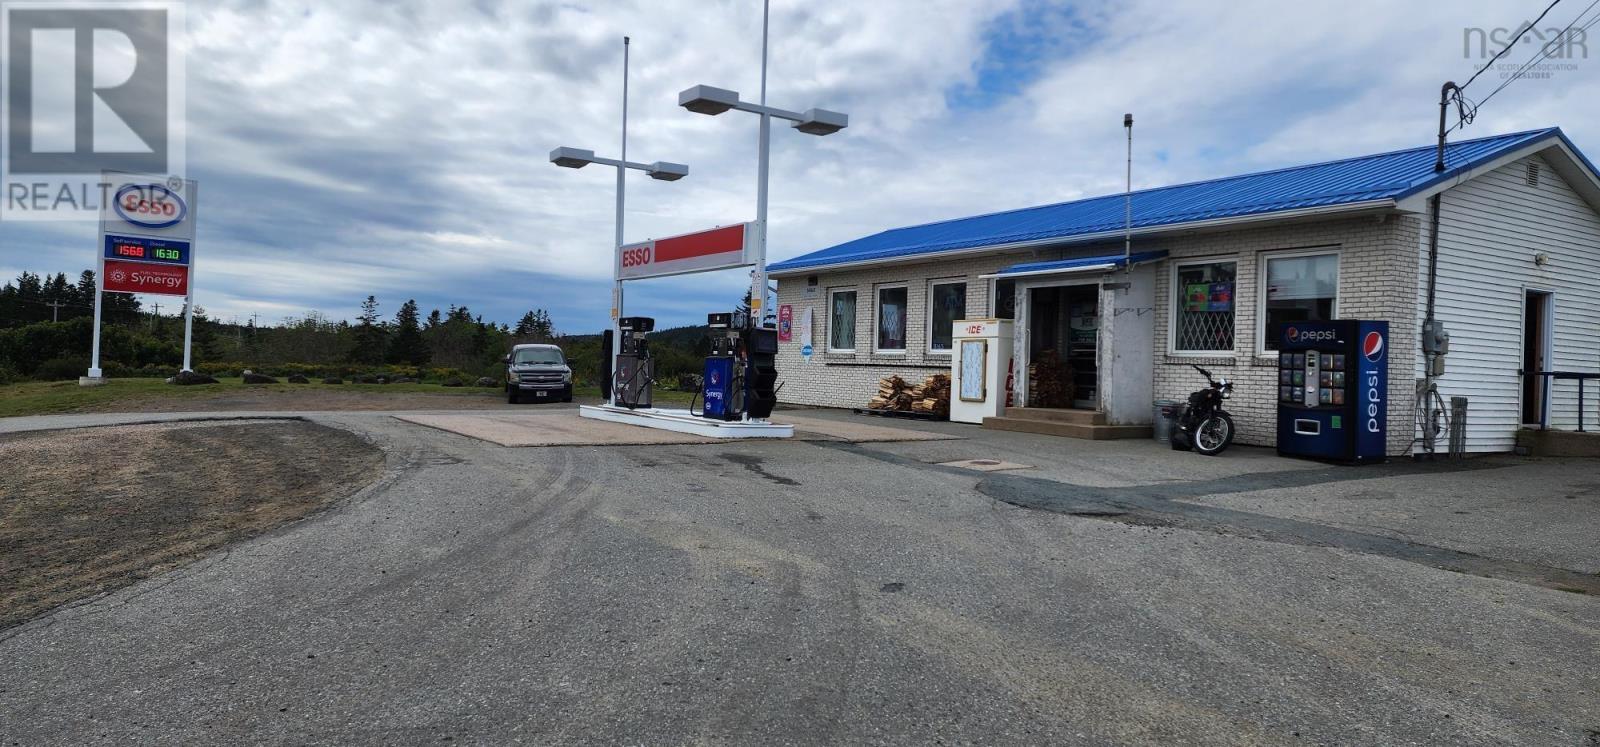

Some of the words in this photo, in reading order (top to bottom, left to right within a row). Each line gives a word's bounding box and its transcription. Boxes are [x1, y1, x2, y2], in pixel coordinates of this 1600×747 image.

[125, 194, 175, 216] ESSO
[622, 247, 650, 268] ESSO
[131, 272, 182, 288] Synergy
[968, 325, 982, 334] ICE
[1301, 329, 1336, 341] pepsi
[705, 389, 724, 401] Synergy
[1366, 370, 1380, 433] pepsi
